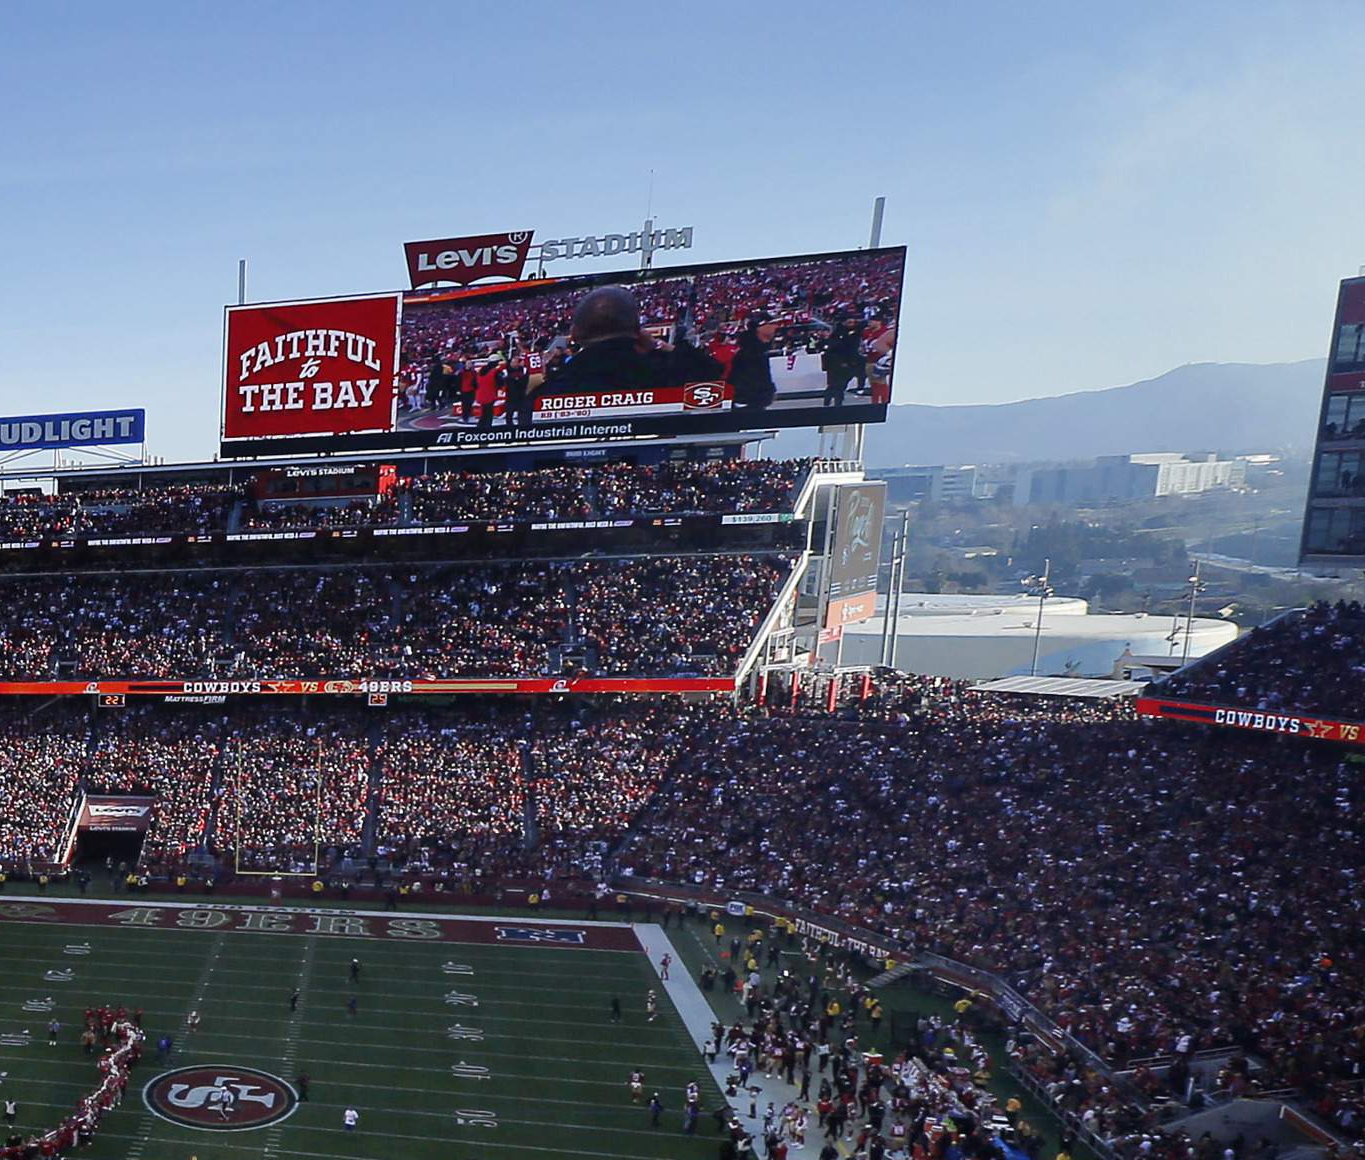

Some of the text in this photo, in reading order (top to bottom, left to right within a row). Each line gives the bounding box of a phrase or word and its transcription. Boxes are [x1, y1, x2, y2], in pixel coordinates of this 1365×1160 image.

[541, 227, 693, 261] STADIUM
[239, 328, 382, 381] FAITHFUL
[300, 357, 320, 379] to
[238, 378, 380, 413] THE BAY
[541, 391, 654, 410] ROGER CRAIG
[457, 422, 632, 443] Foxconn Industrial Internet
[317, 467, 356, 477] STADIUM
[183, 681, 413, 693] COWBOYS VS 49ERS
[1215, 709, 1360, 740] COWBOYS VS
[107, 904, 446, 941] 49ERS
